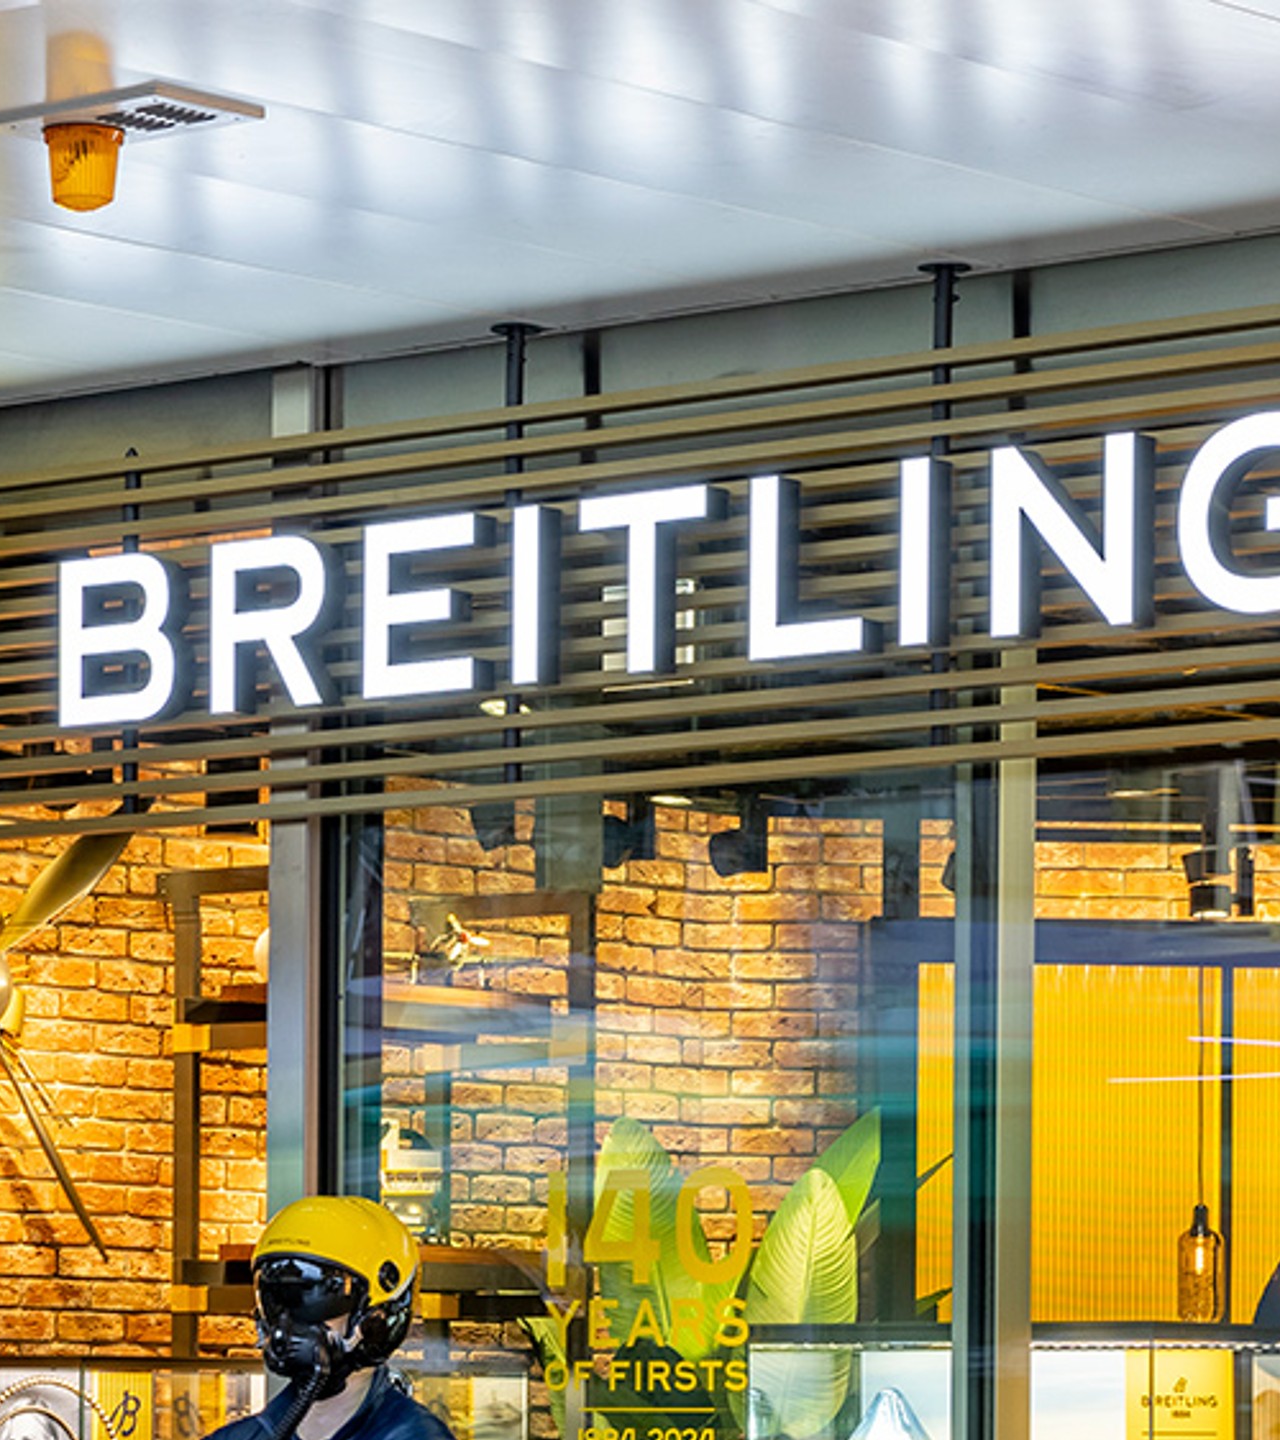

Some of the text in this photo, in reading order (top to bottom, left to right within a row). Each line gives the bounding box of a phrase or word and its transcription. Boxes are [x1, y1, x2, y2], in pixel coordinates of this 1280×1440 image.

[547, 1167, 753, 1288] 140
[544, 1298, 749, 1348] YEARS
[544, 1361, 748, 1392] OF FIRSTS
